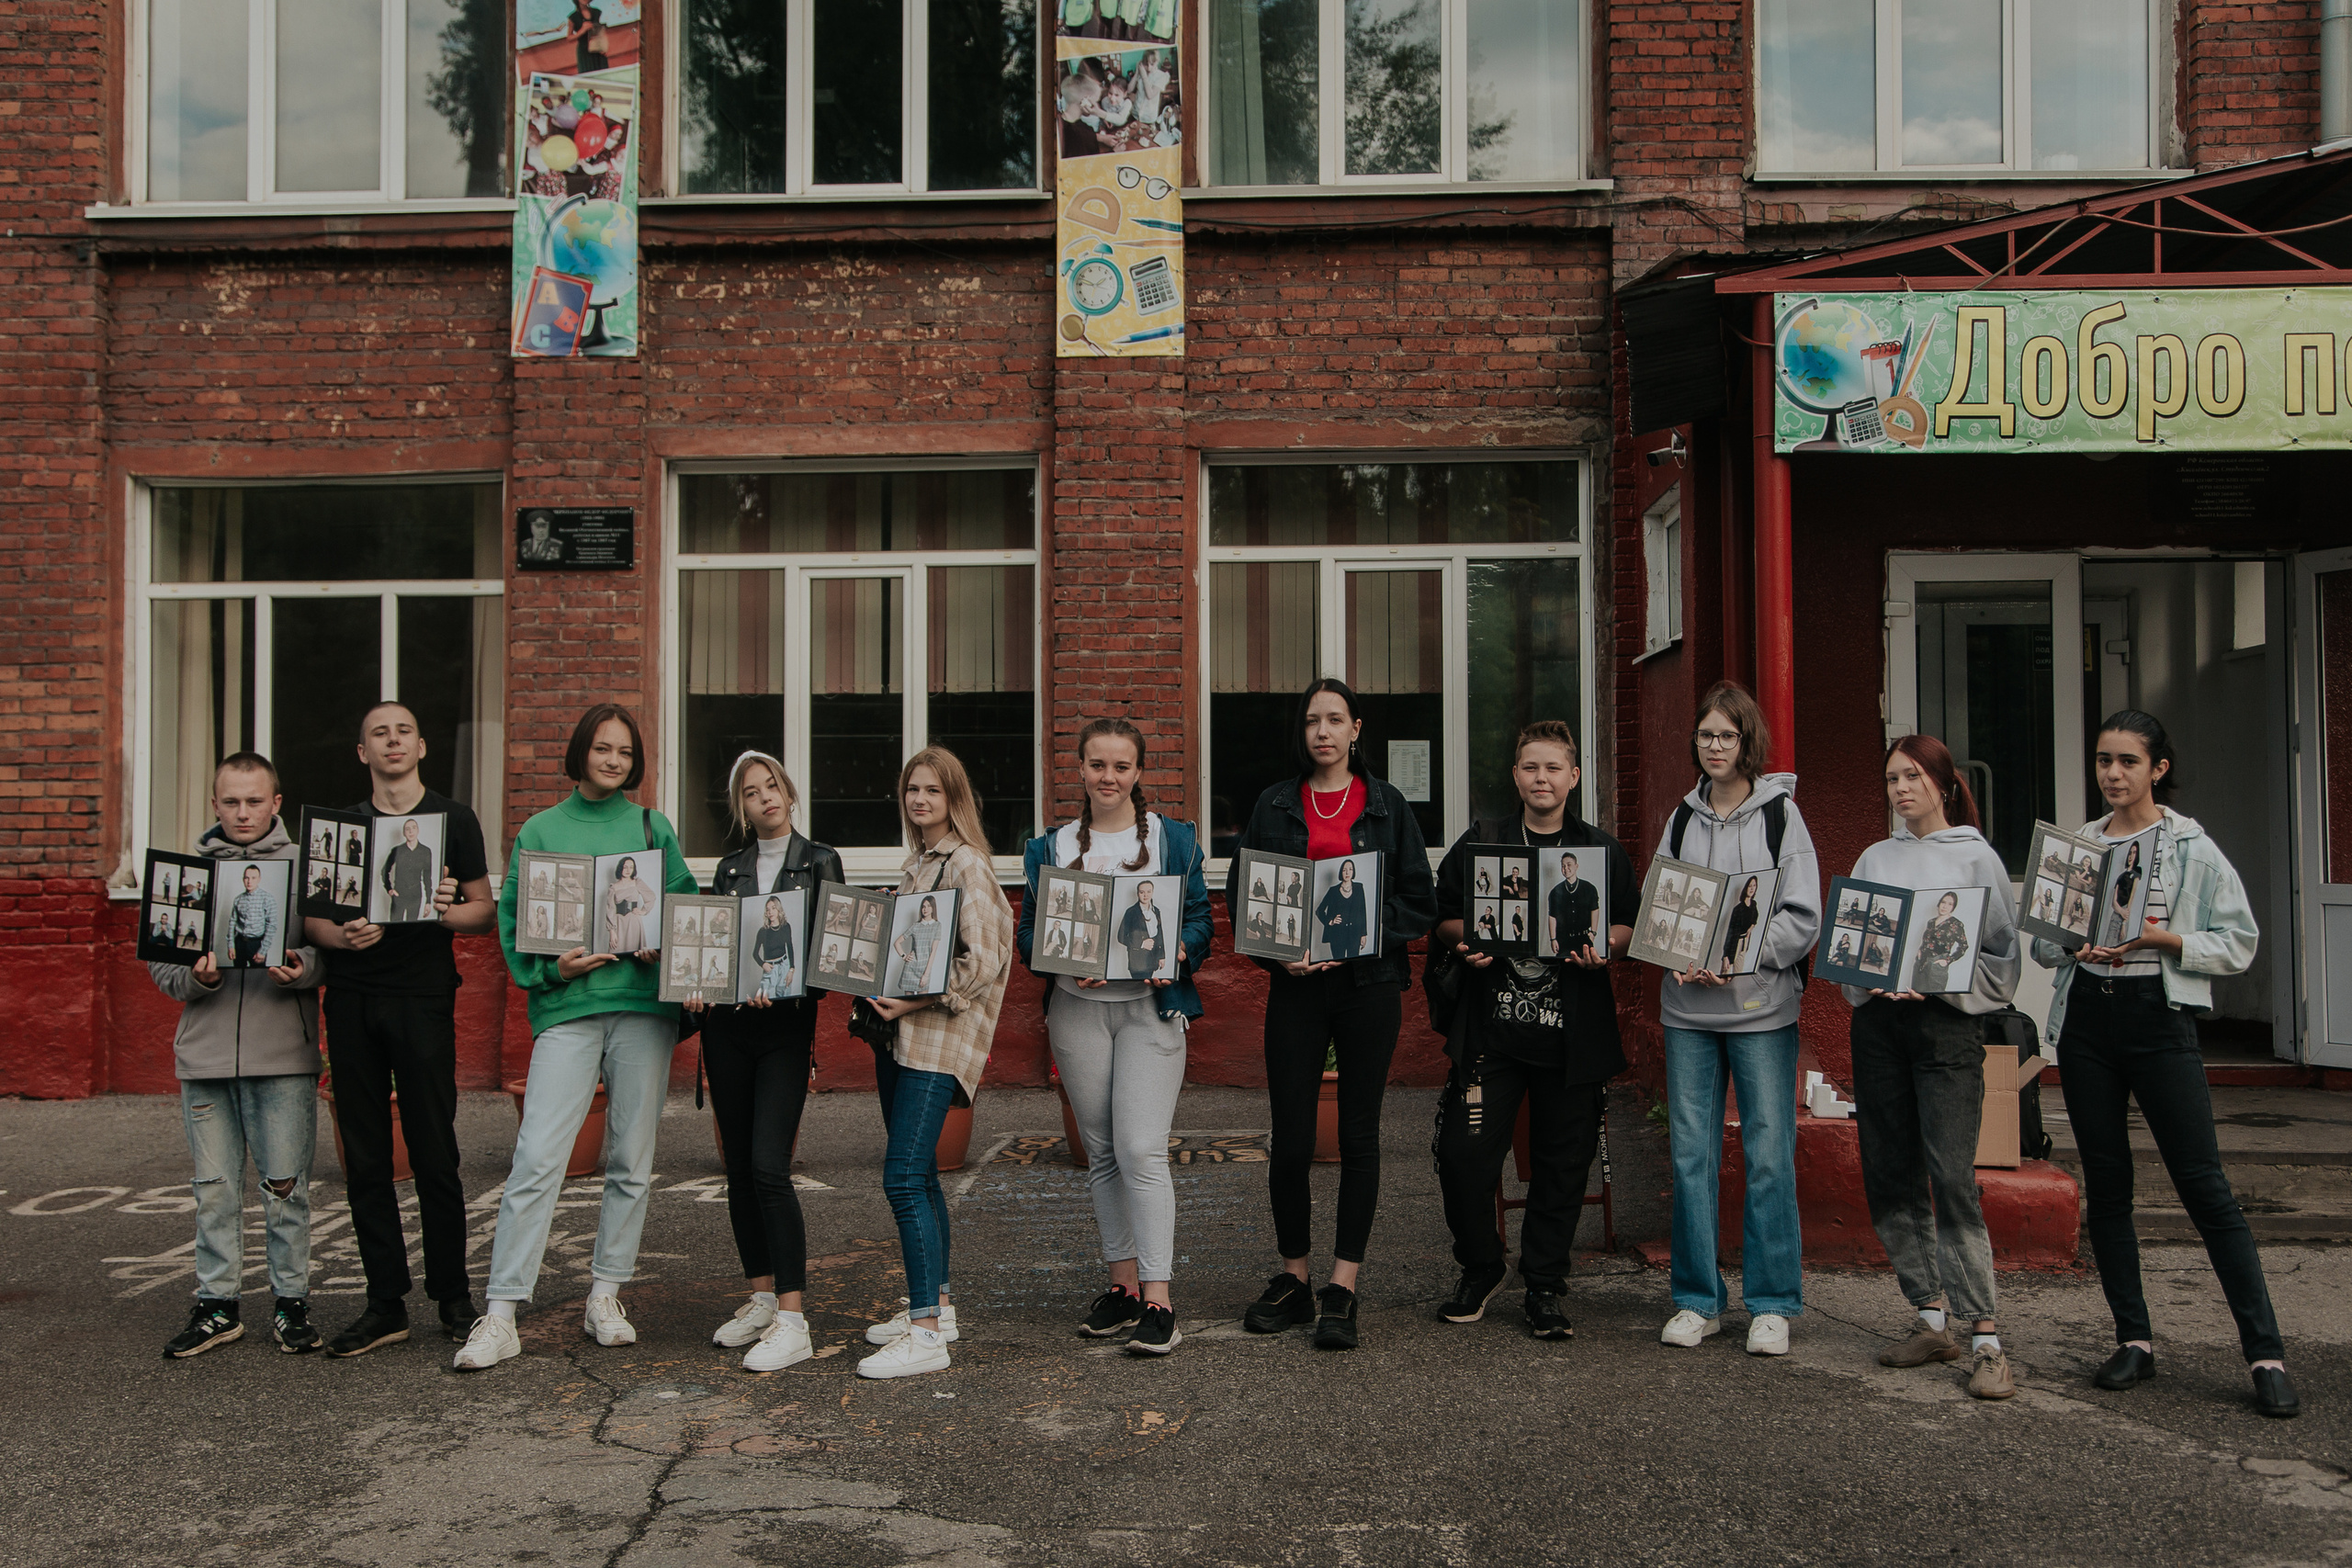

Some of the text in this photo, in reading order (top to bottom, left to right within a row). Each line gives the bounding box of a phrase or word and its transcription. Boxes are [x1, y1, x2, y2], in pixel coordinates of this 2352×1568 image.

[1933, 300, 2352, 443] Добро п
[1599, 1134, 1609, 1161] SNOW
